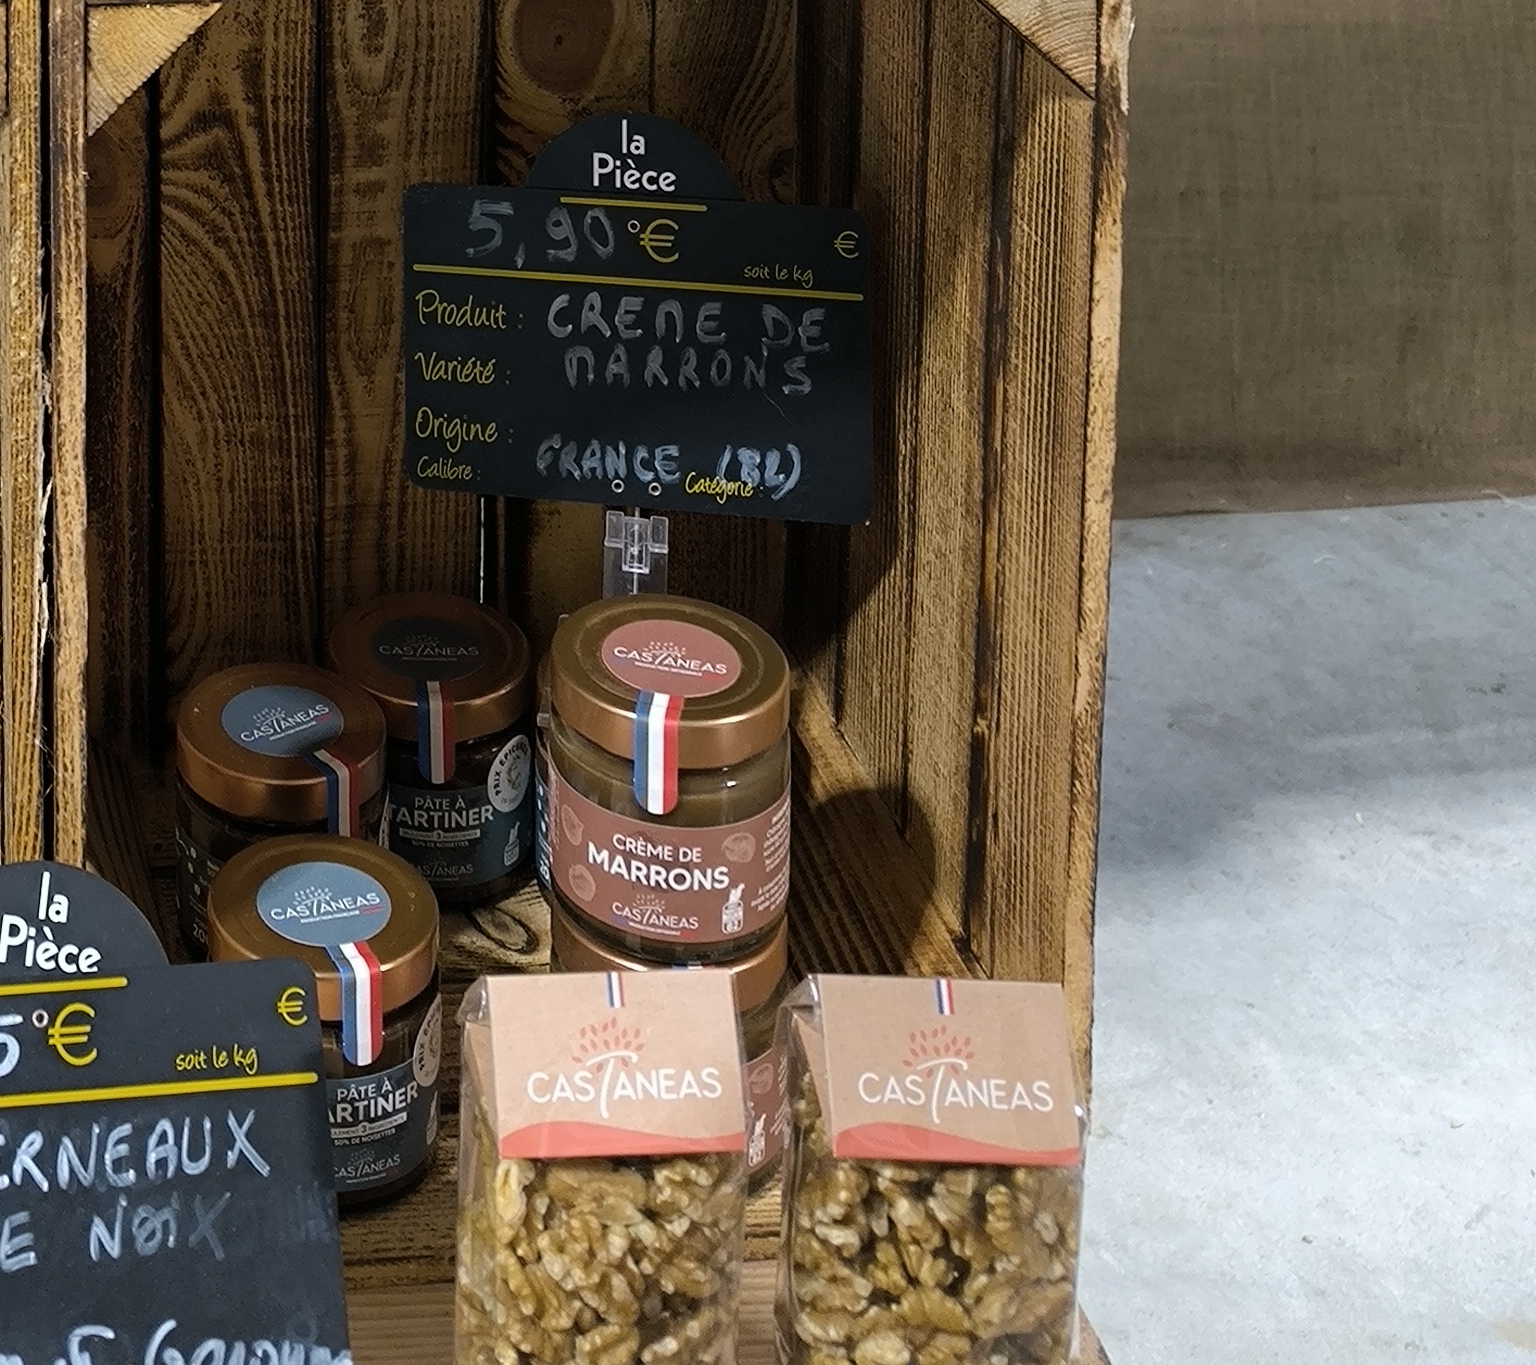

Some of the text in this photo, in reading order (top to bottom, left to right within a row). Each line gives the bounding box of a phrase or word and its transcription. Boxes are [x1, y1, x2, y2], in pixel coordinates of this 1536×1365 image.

[621, 118, 646, 156] la
[592, 152, 677, 192] Pièce
[464, 199, 679, 269] 5,90 €
[744, 264, 814, 287] soit le kg
[415, 289, 507, 330] Produit
[761, 303, 830, 353] DE
[415, 351, 496, 385] Variété
[415, 406, 499, 452] Origine
[535, 433, 681, 483] FRANCE
[416, 456, 755, 503] Calibre Catégorie
[614, 645, 727, 675] CASTANEAS
[587, 841, 729, 891] MARRONS
[613, 832, 702, 863] CRÈME DE
[37, 872, 68, 923] la
[270, 892, 381, 921] CASTANEAS
[612, 901, 699, 930] CASTANEAS
[48, 1002, 98, 1066] €
[175, 1044, 258, 1075] soit le kg
[527, 1050, 723, 1119] CASTANEAS
[858, 1057, 1054, 1123] CASTANEAS
[90, 1193, 231, 1260] NOIX
